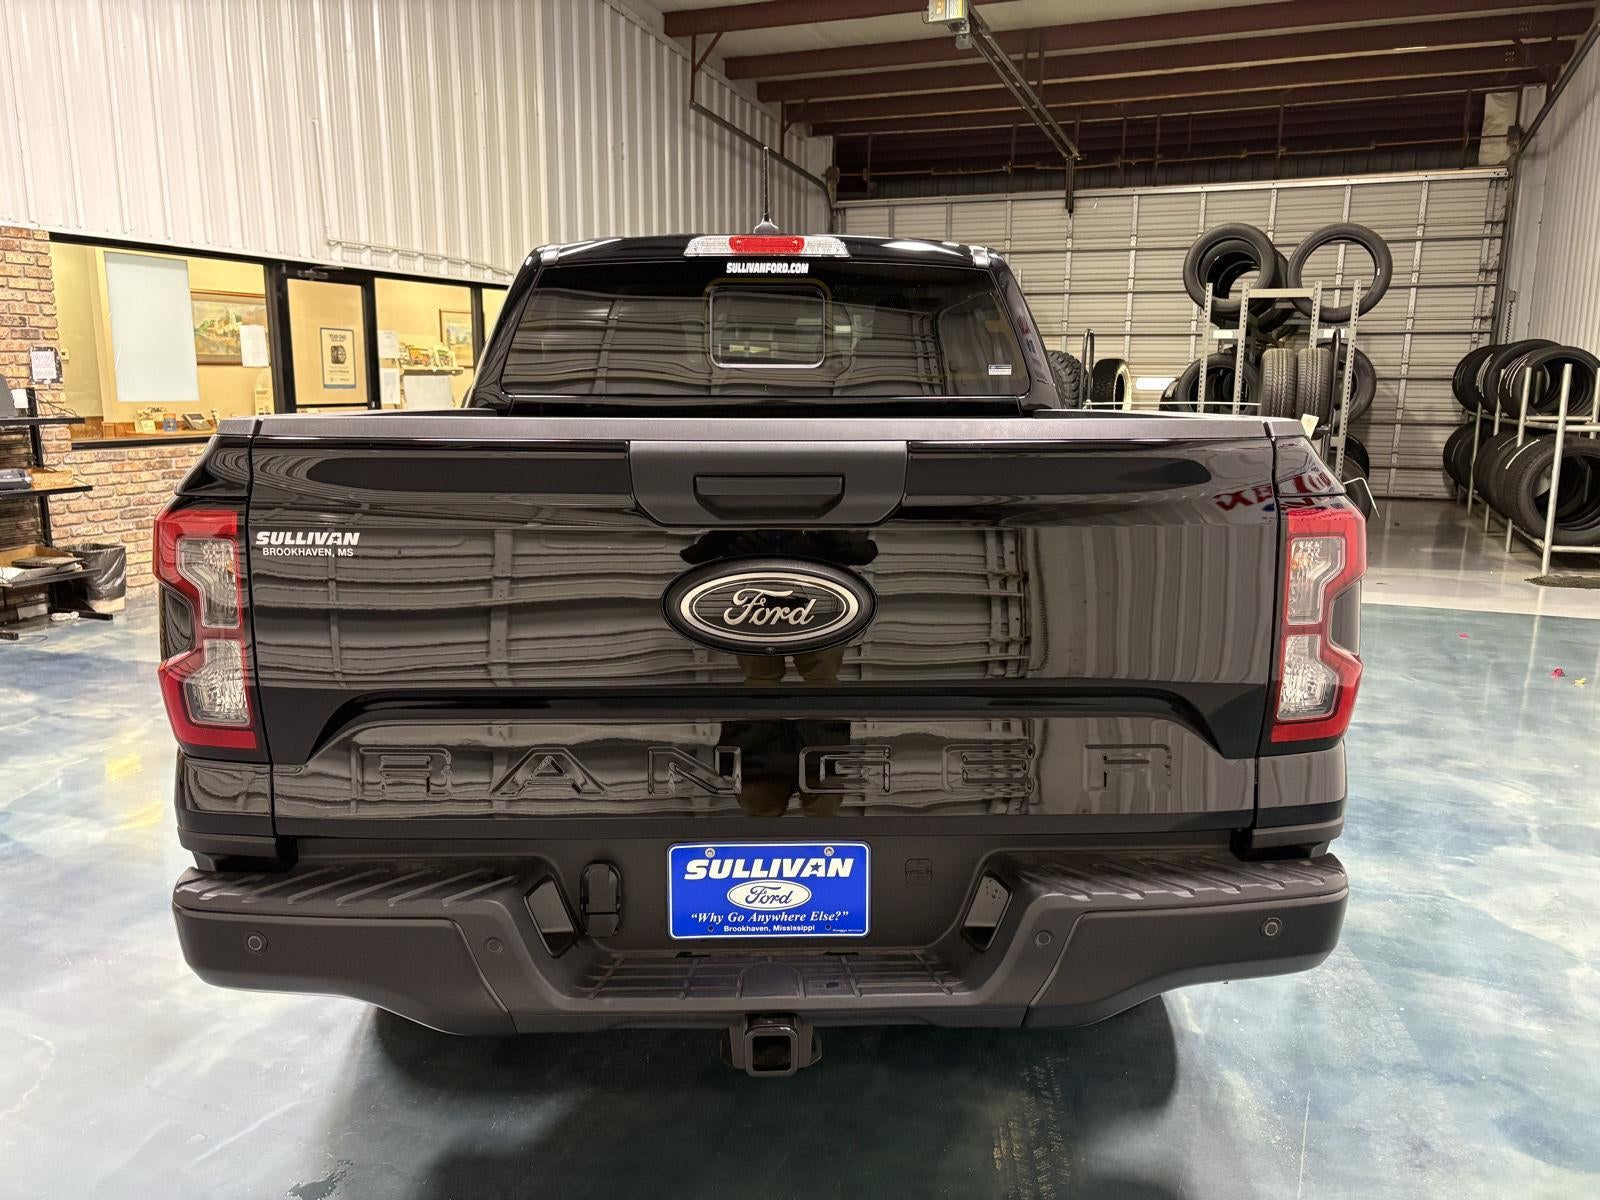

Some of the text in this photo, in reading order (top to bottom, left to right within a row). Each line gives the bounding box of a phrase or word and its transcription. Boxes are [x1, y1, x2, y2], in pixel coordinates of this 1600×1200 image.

[726, 262, 809, 274] SULLIVANFORD.COM
[255, 531, 360, 546] SULLIVAN
[262, 547, 354, 557] BROOKHAVEN, MS
[723, 588, 818, 626] Ford
[351, 743, 1172, 797] RANGER
[683, 857, 854, 880] SULLIVAN
[744, 885, 793, 905] Ford
[727, 912, 745, 923] Go
[748, 911, 807, 924] Anywhere
[773, 924, 815, 932] Mississippi
